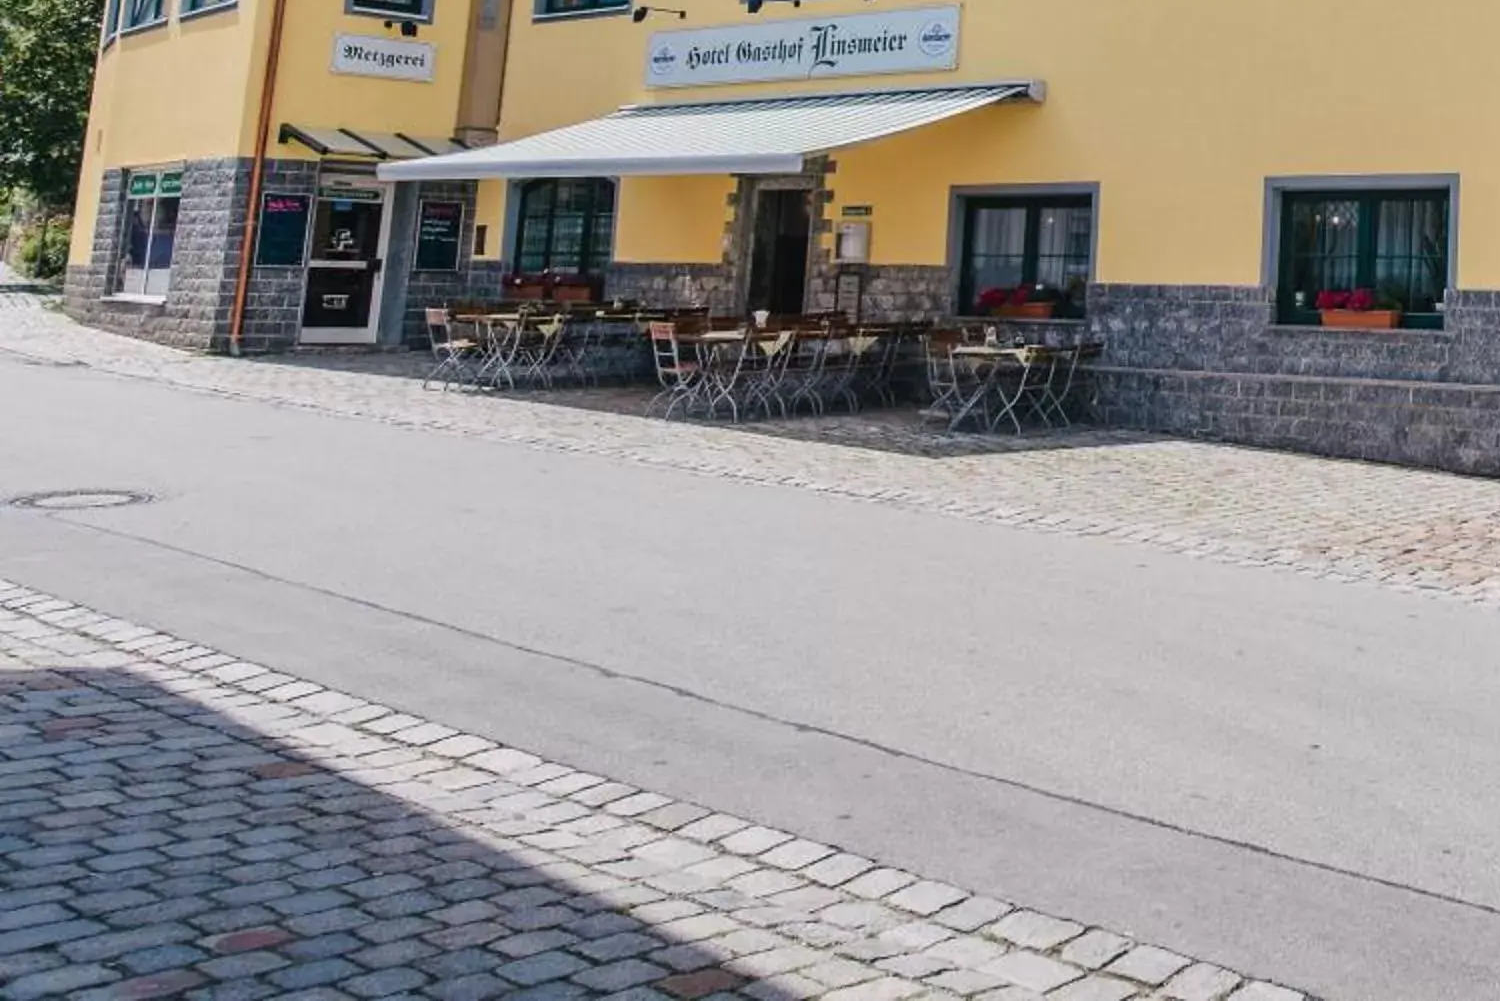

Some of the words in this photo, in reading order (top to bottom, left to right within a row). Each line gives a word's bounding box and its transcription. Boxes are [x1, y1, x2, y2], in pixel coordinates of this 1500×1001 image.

[343, 45, 425, 68] Metzgerei
[685, 44, 730, 70] Hotel
[735, 37, 804, 63] Gasthof
[810, 23, 907, 68] Linsmeier
